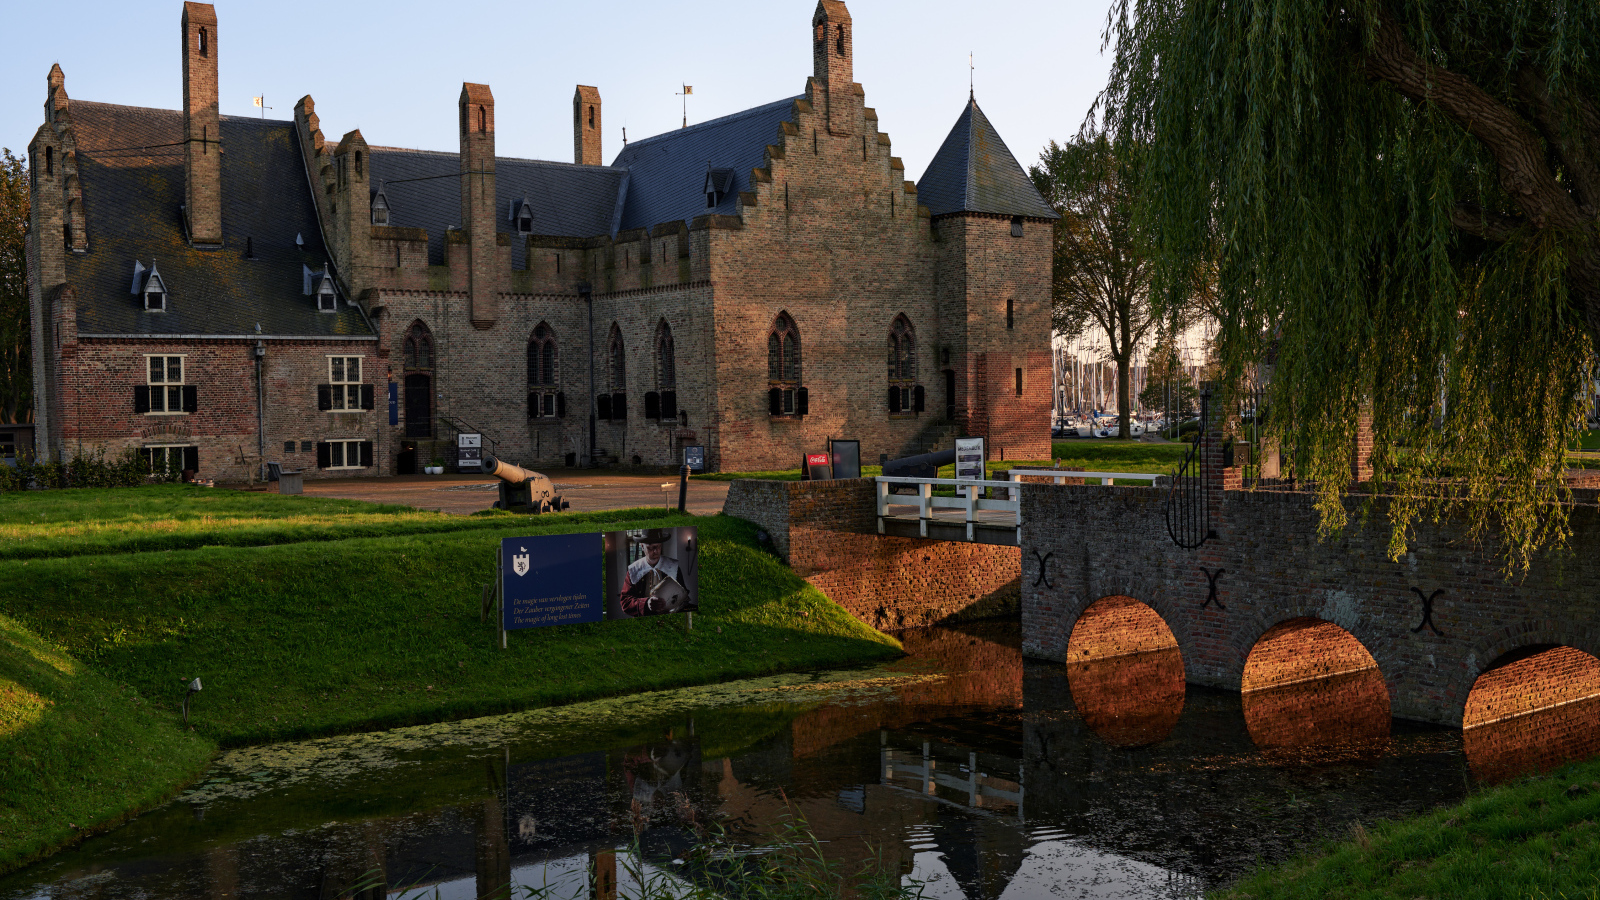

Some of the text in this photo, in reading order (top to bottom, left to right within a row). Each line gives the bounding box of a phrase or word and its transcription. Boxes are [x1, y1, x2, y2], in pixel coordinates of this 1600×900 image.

[514, 598, 521, 606] De
[522, 597, 538, 606] magie
[549, 594, 572, 603] vervlogen
[573, 593, 587, 602] tijden
[514, 602, 590, 615] Der Zauber vergangener Zeiten
[514, 616, 524, 624] The
[525, 616, 541, 625] magic
[541, 613, 548, 624] of
[548, 614, 559, 623] long
